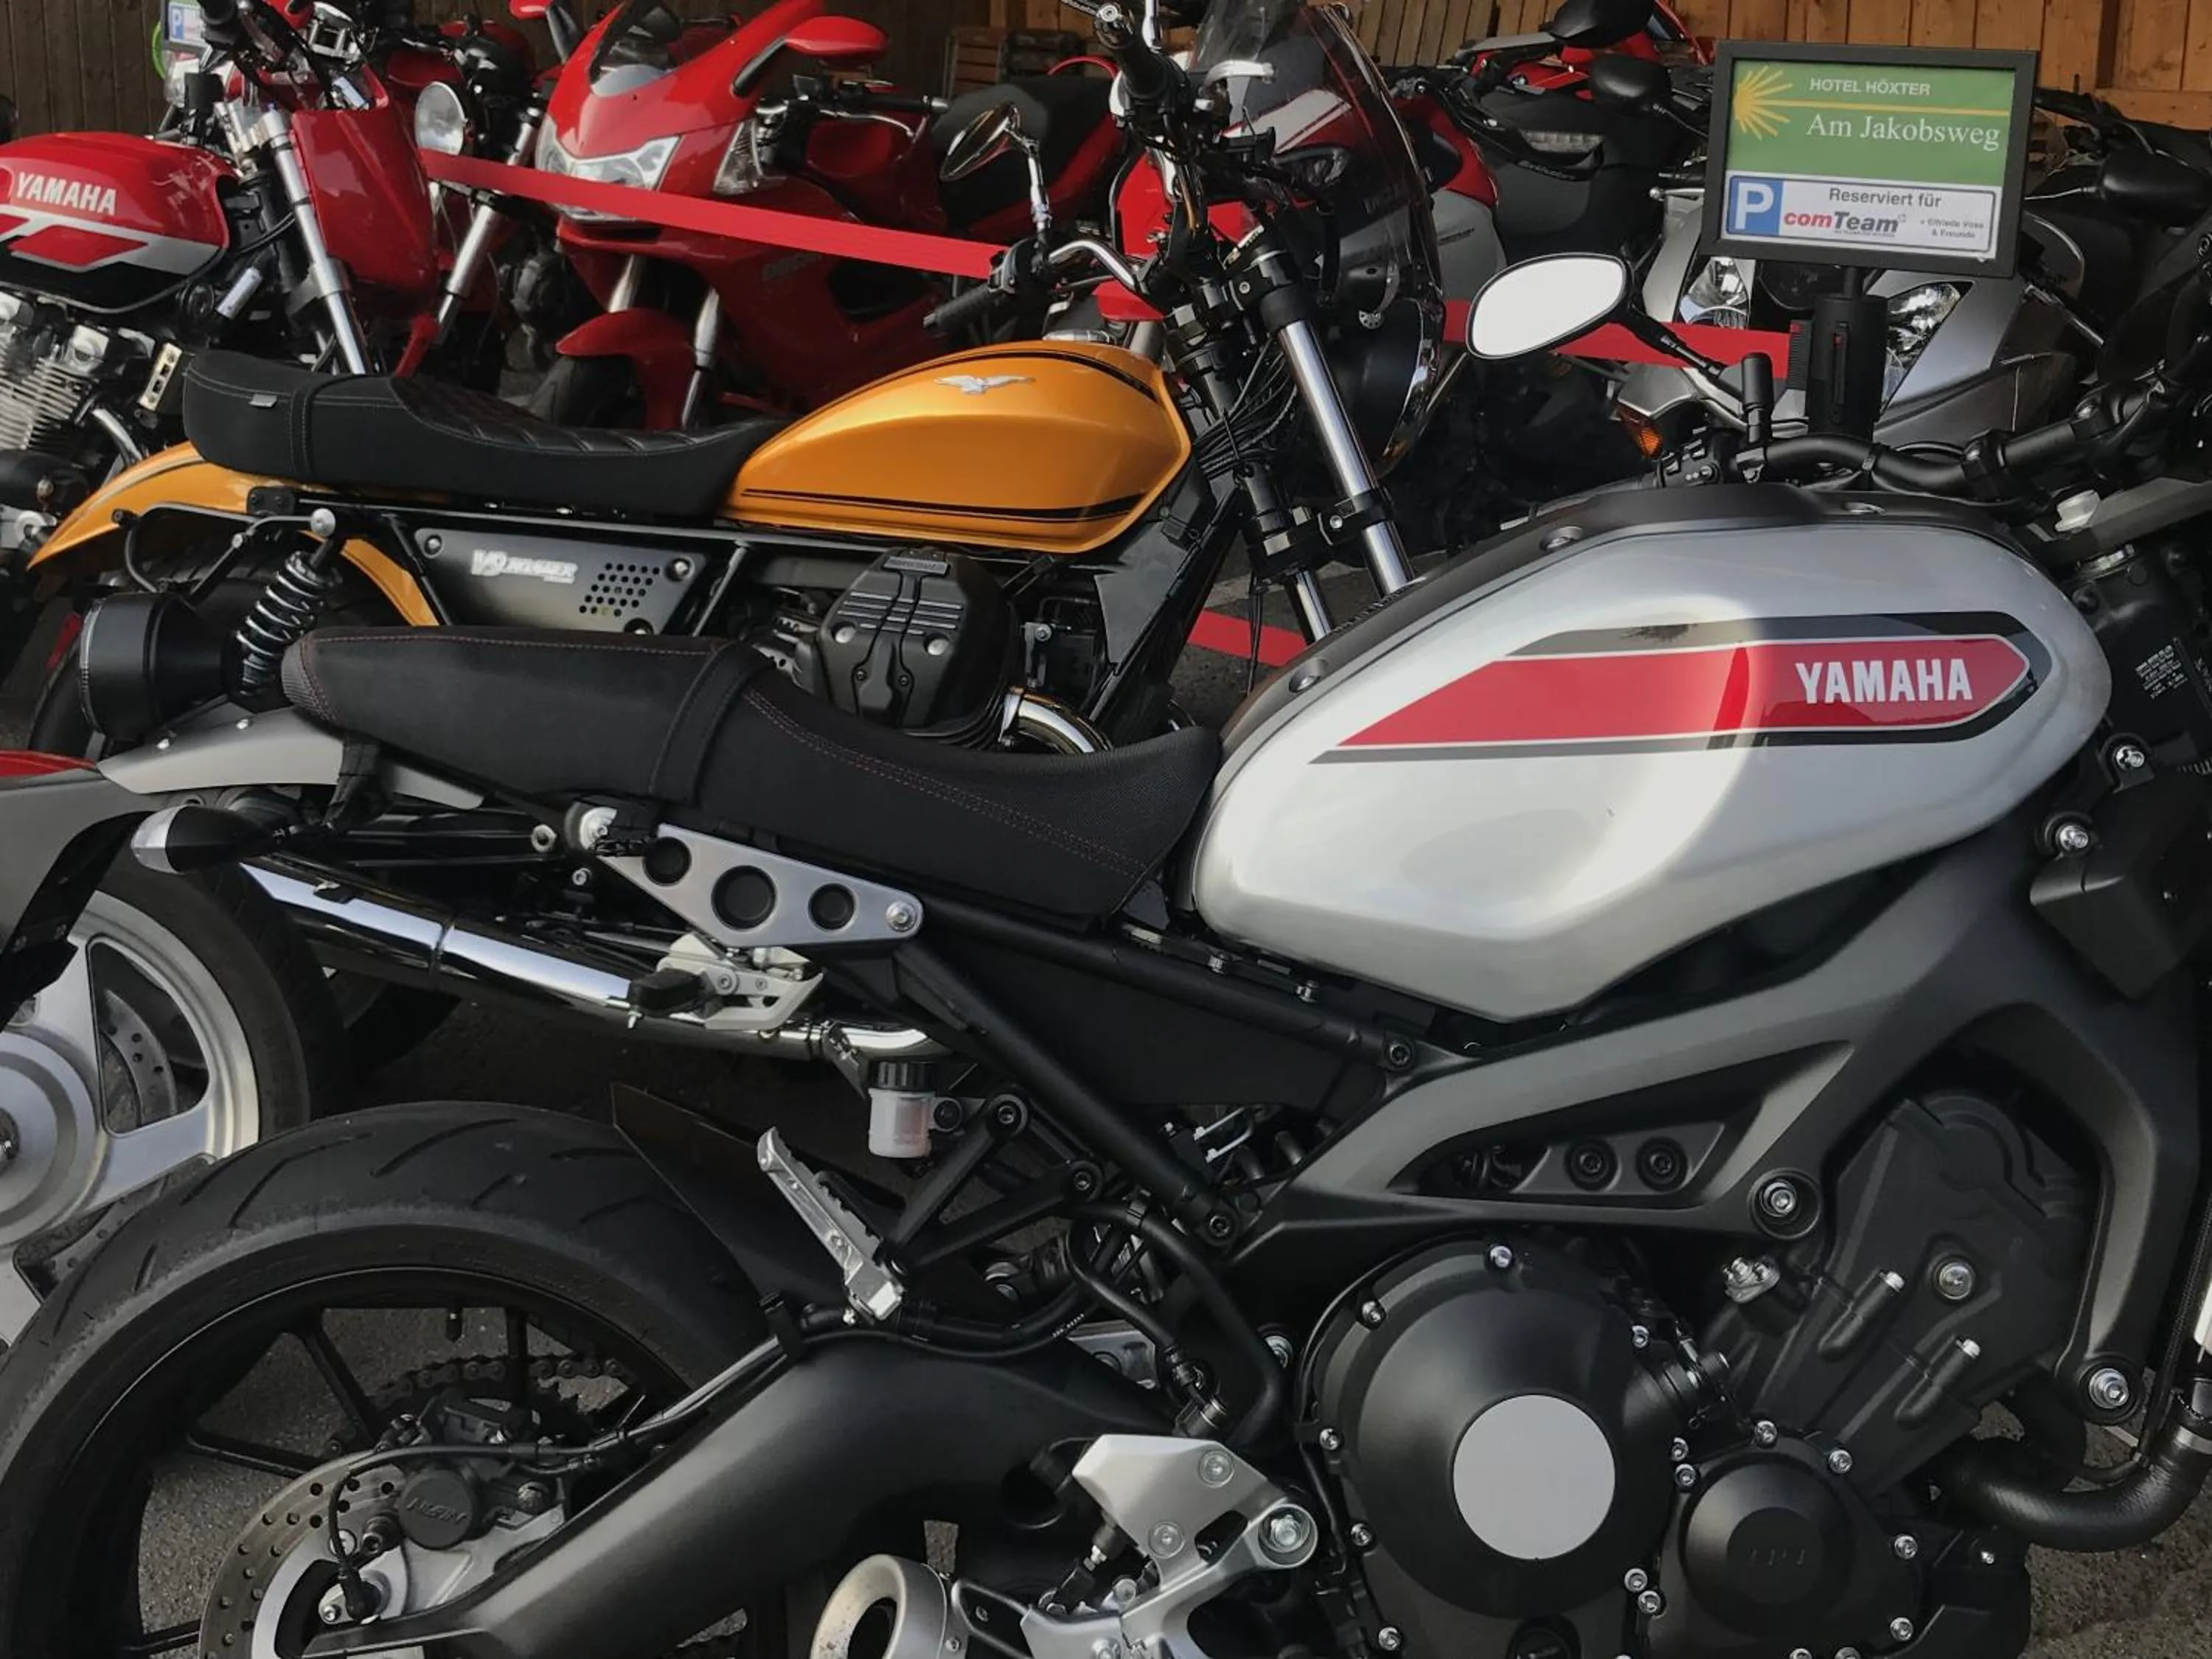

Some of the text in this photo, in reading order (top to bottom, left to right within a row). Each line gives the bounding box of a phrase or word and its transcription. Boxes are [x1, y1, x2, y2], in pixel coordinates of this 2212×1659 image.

[1809, 78, 1931, 96] HOTEL HÖXTER
[1806, 113, 2001, 151] Am Jakobsweg
[17, 171, 116, 215] YAMAHA
[1735, 182, 1774, 229] P
[1829, 187, 1942, 208] Reserviert für
[1783, 210, 1899, 233] comTeam
[1795, 658, 1972, 704] YAMAHA
